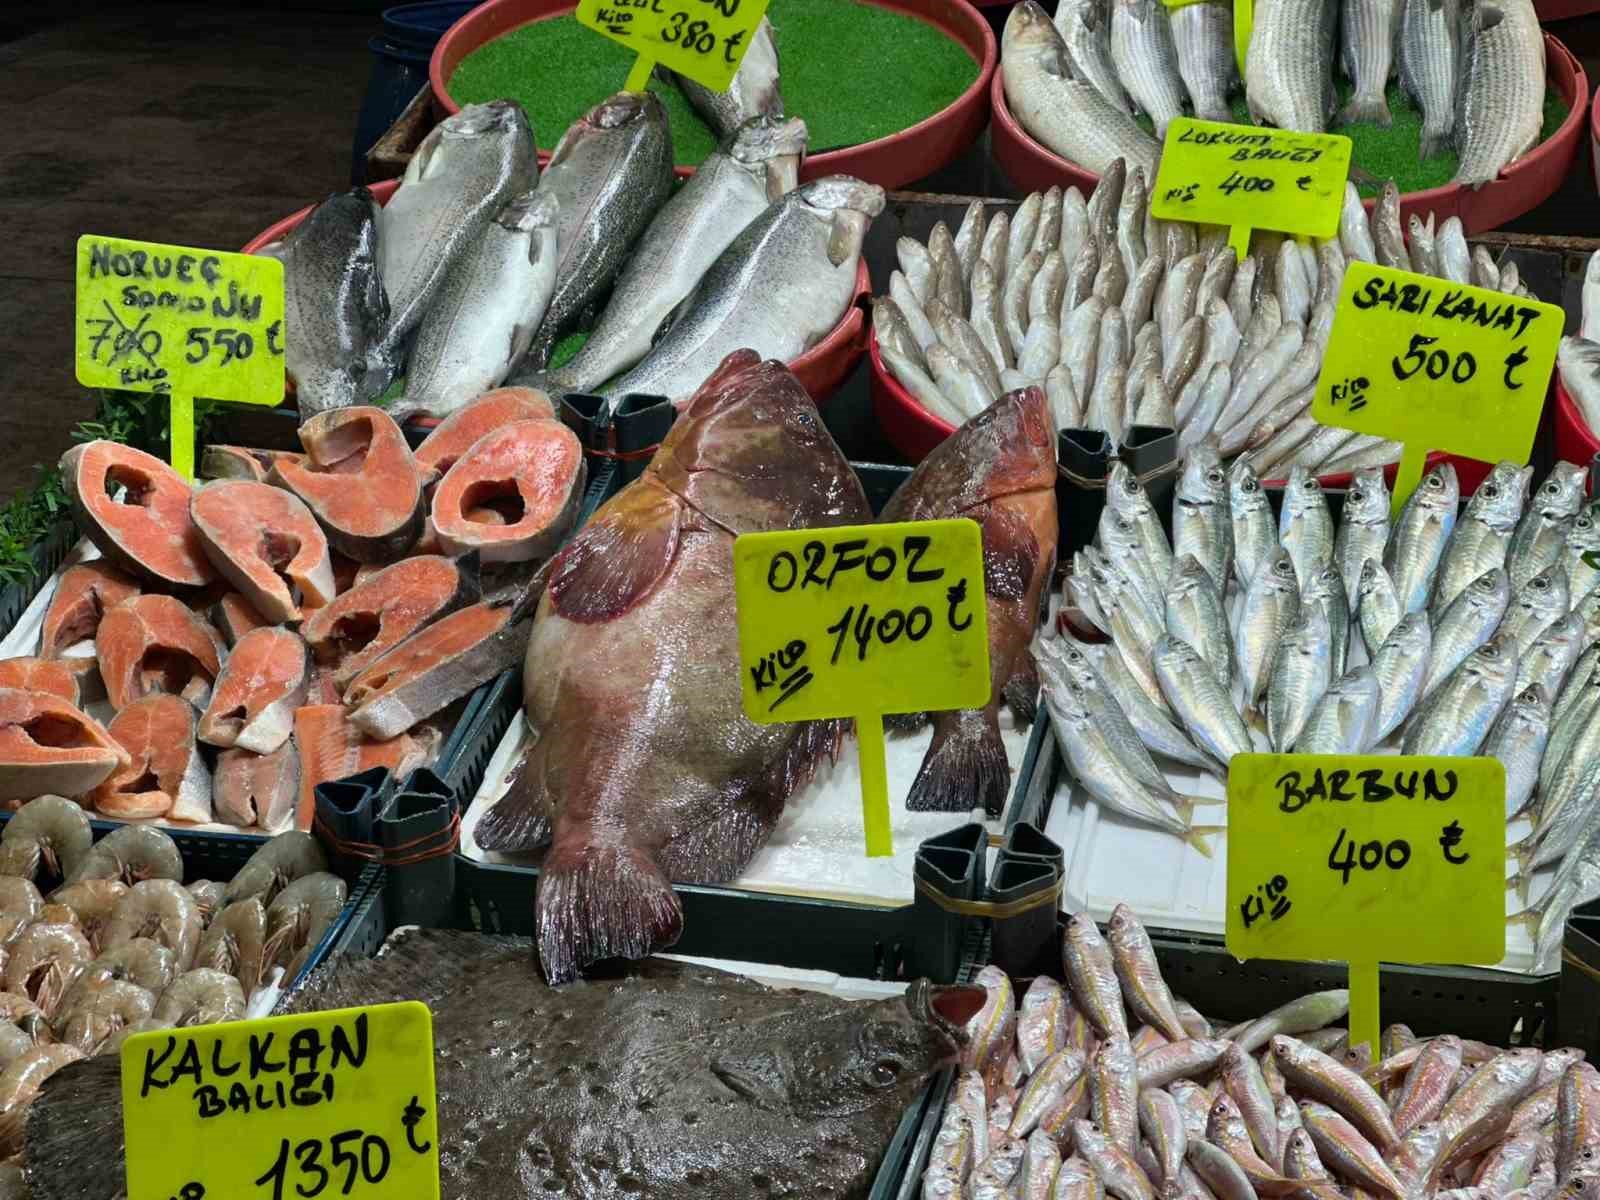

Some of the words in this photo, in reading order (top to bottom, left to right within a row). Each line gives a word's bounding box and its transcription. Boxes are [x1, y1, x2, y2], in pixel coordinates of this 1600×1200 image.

[661, 12, 715, 54] 380
[1218, 171, 1275, 195] 400
[1432, 290, 1541, 340] KANAT
[185, 327, 254, 367] 550
[1392, 333, 1477, 383] 500
[827, 604, 932, 665] 1400
[1328, 828, 1411, 885] 400
[140, 1013, 368, 1098] KALKAN
[256, 1129, 391, 1200] 1350
